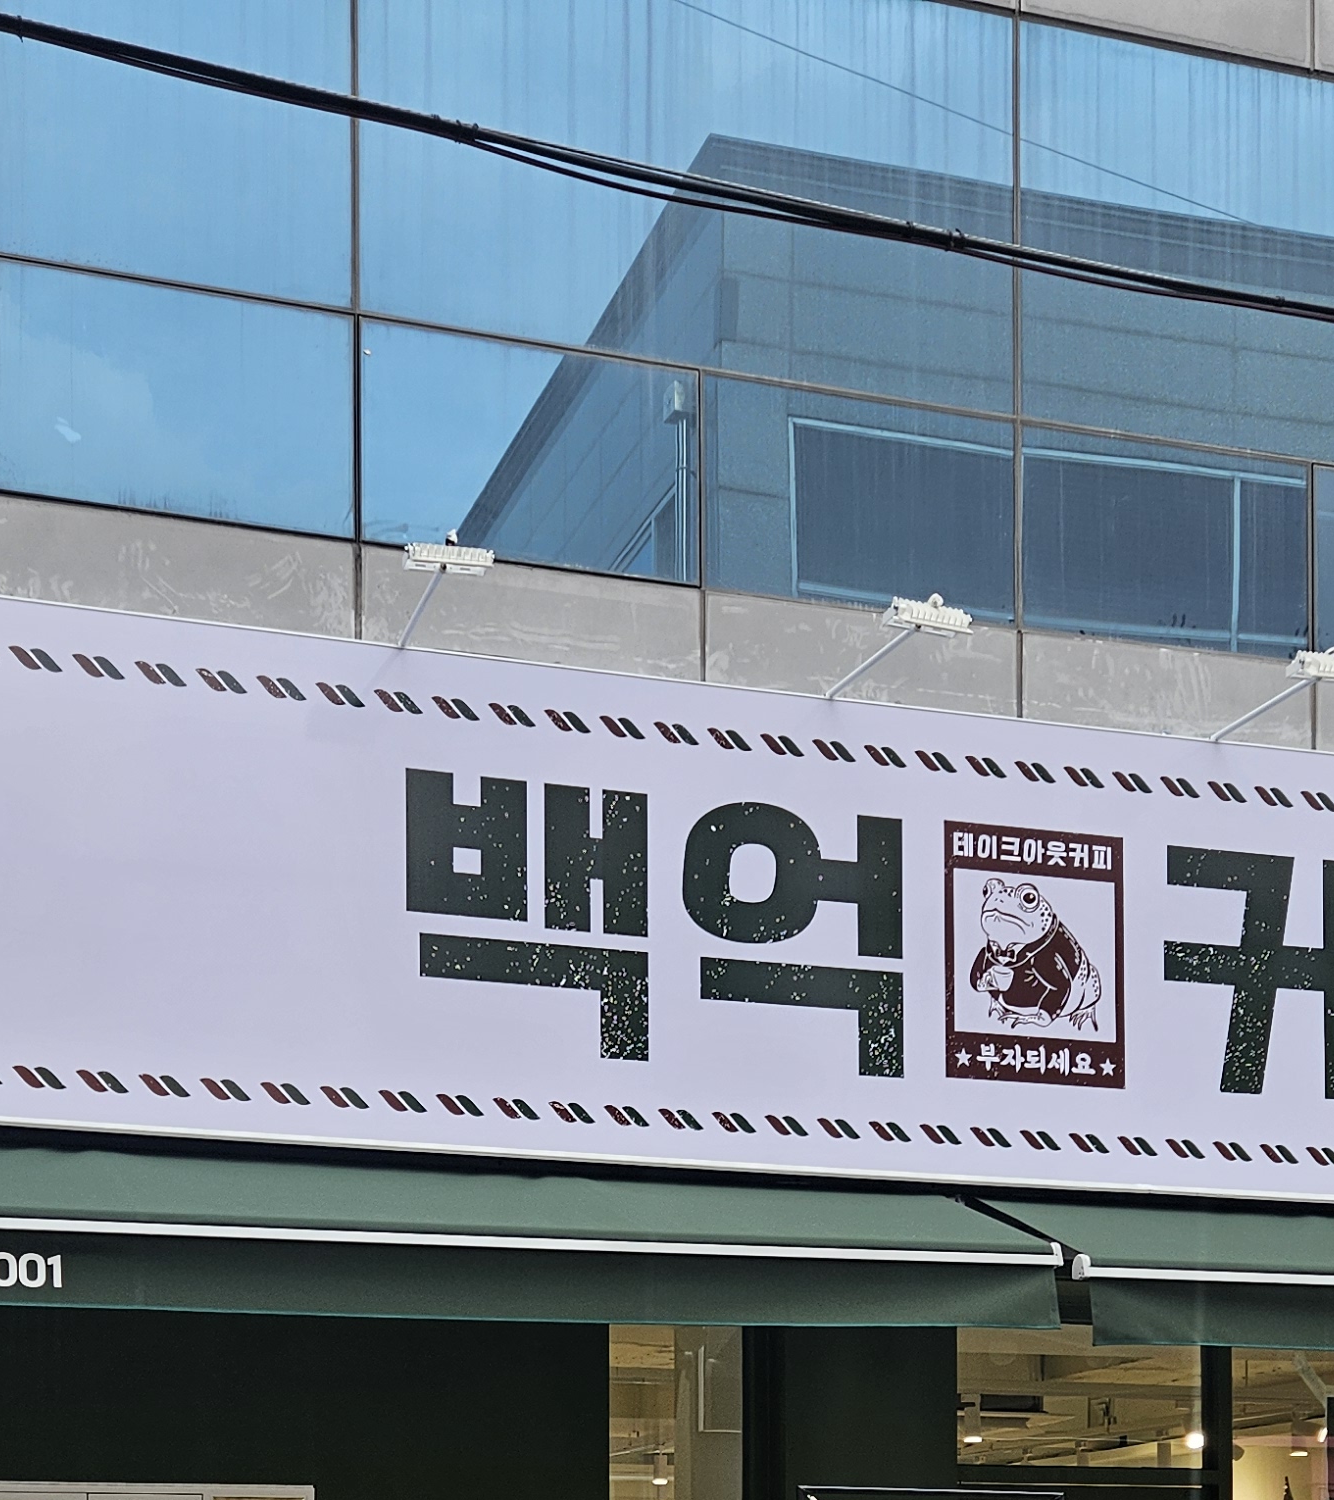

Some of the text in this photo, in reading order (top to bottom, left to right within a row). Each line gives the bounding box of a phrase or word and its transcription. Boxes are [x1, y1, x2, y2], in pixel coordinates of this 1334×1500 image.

[953, 832, 1112, 870] 테이크아웃커피
[405, 767, 904, 1078] 백억
[977, 1043, 1096, 1075] 부자되세요
